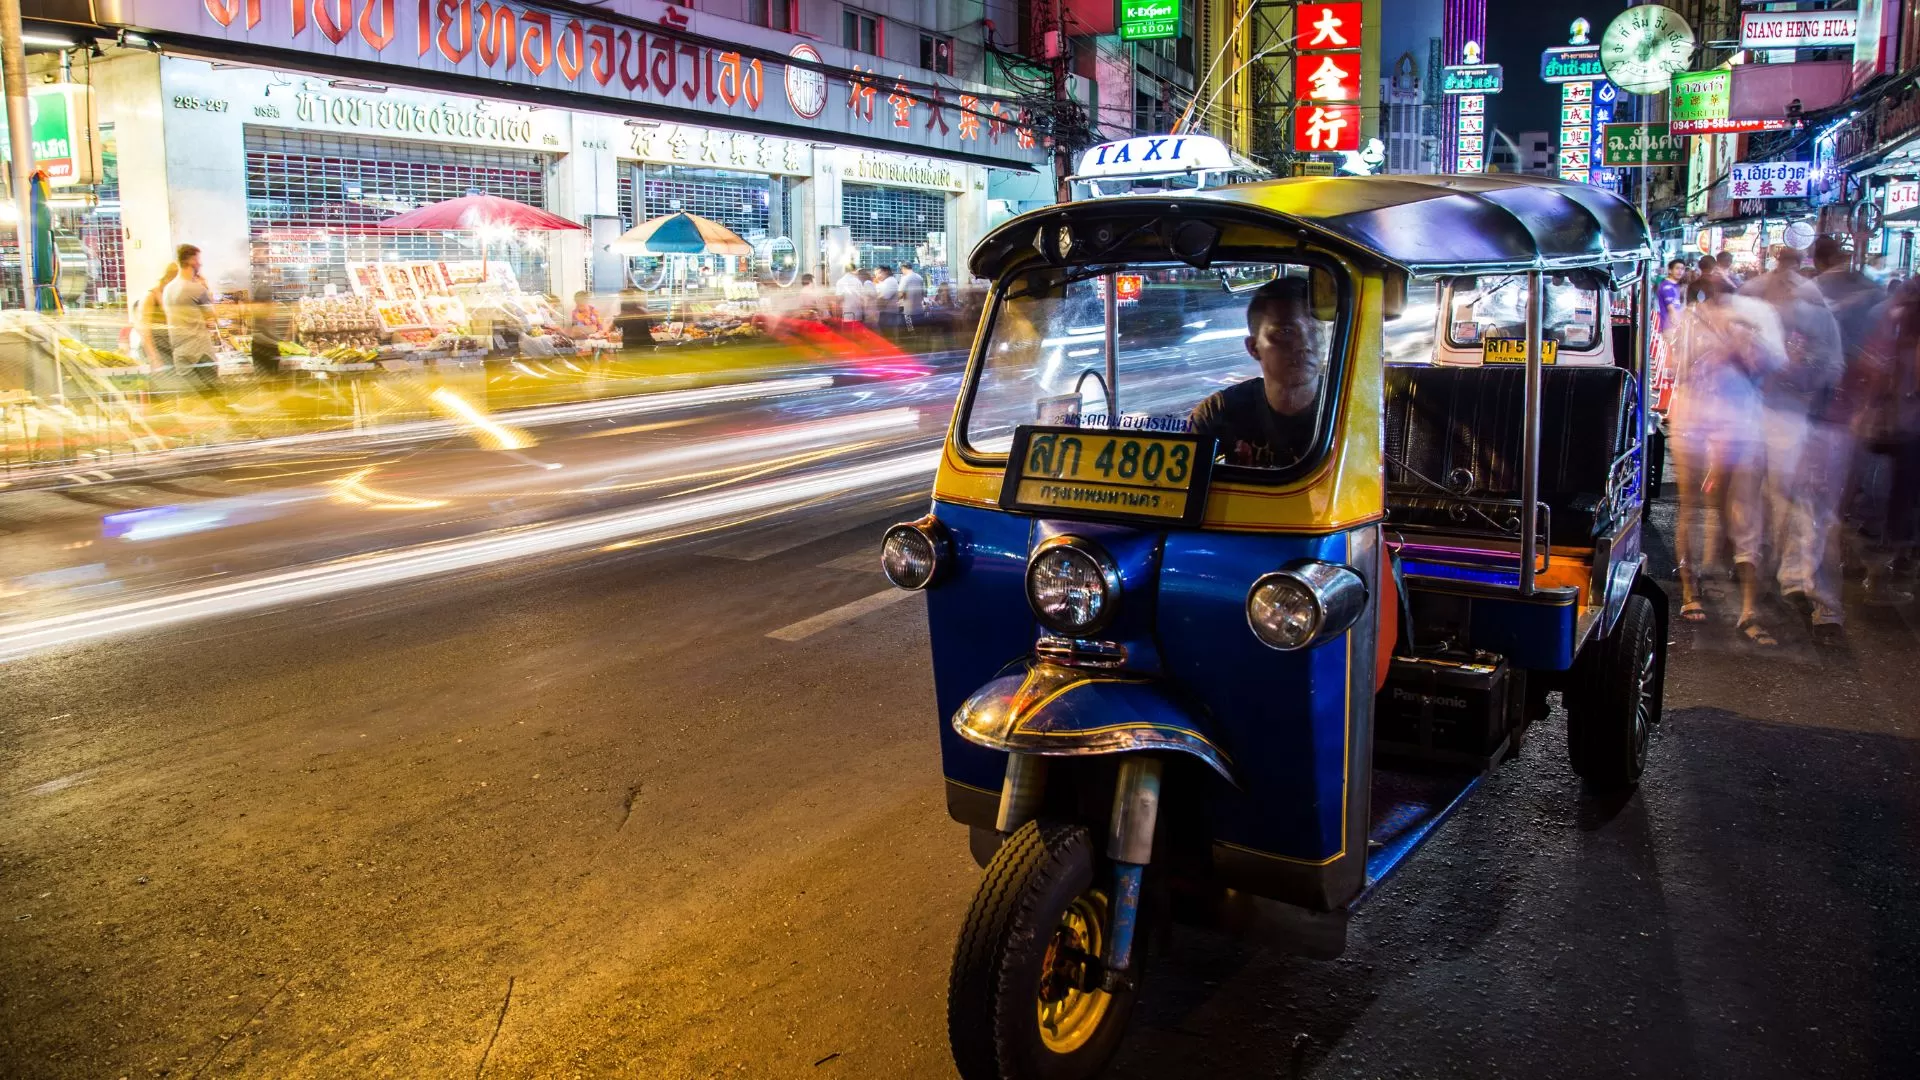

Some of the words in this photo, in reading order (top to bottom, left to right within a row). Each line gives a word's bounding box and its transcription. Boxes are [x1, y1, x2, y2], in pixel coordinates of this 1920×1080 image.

[1127, 4, 1172, 18] K-Expert
[1127, 24, 1174, 34] WISDOM
[1746, 22, 1783, 39] SIANG
[1786, 21, 1819, 38] HENG
[1823, 19, 1850, 37] HUA
[175, 95, 229, 113] 295-297
[1096, 138, 1188, 165] TAXI
[1094, 439, 1191, 484] 4803
[1040, 485, 1161, 509] กรุงเทพมหานคร
